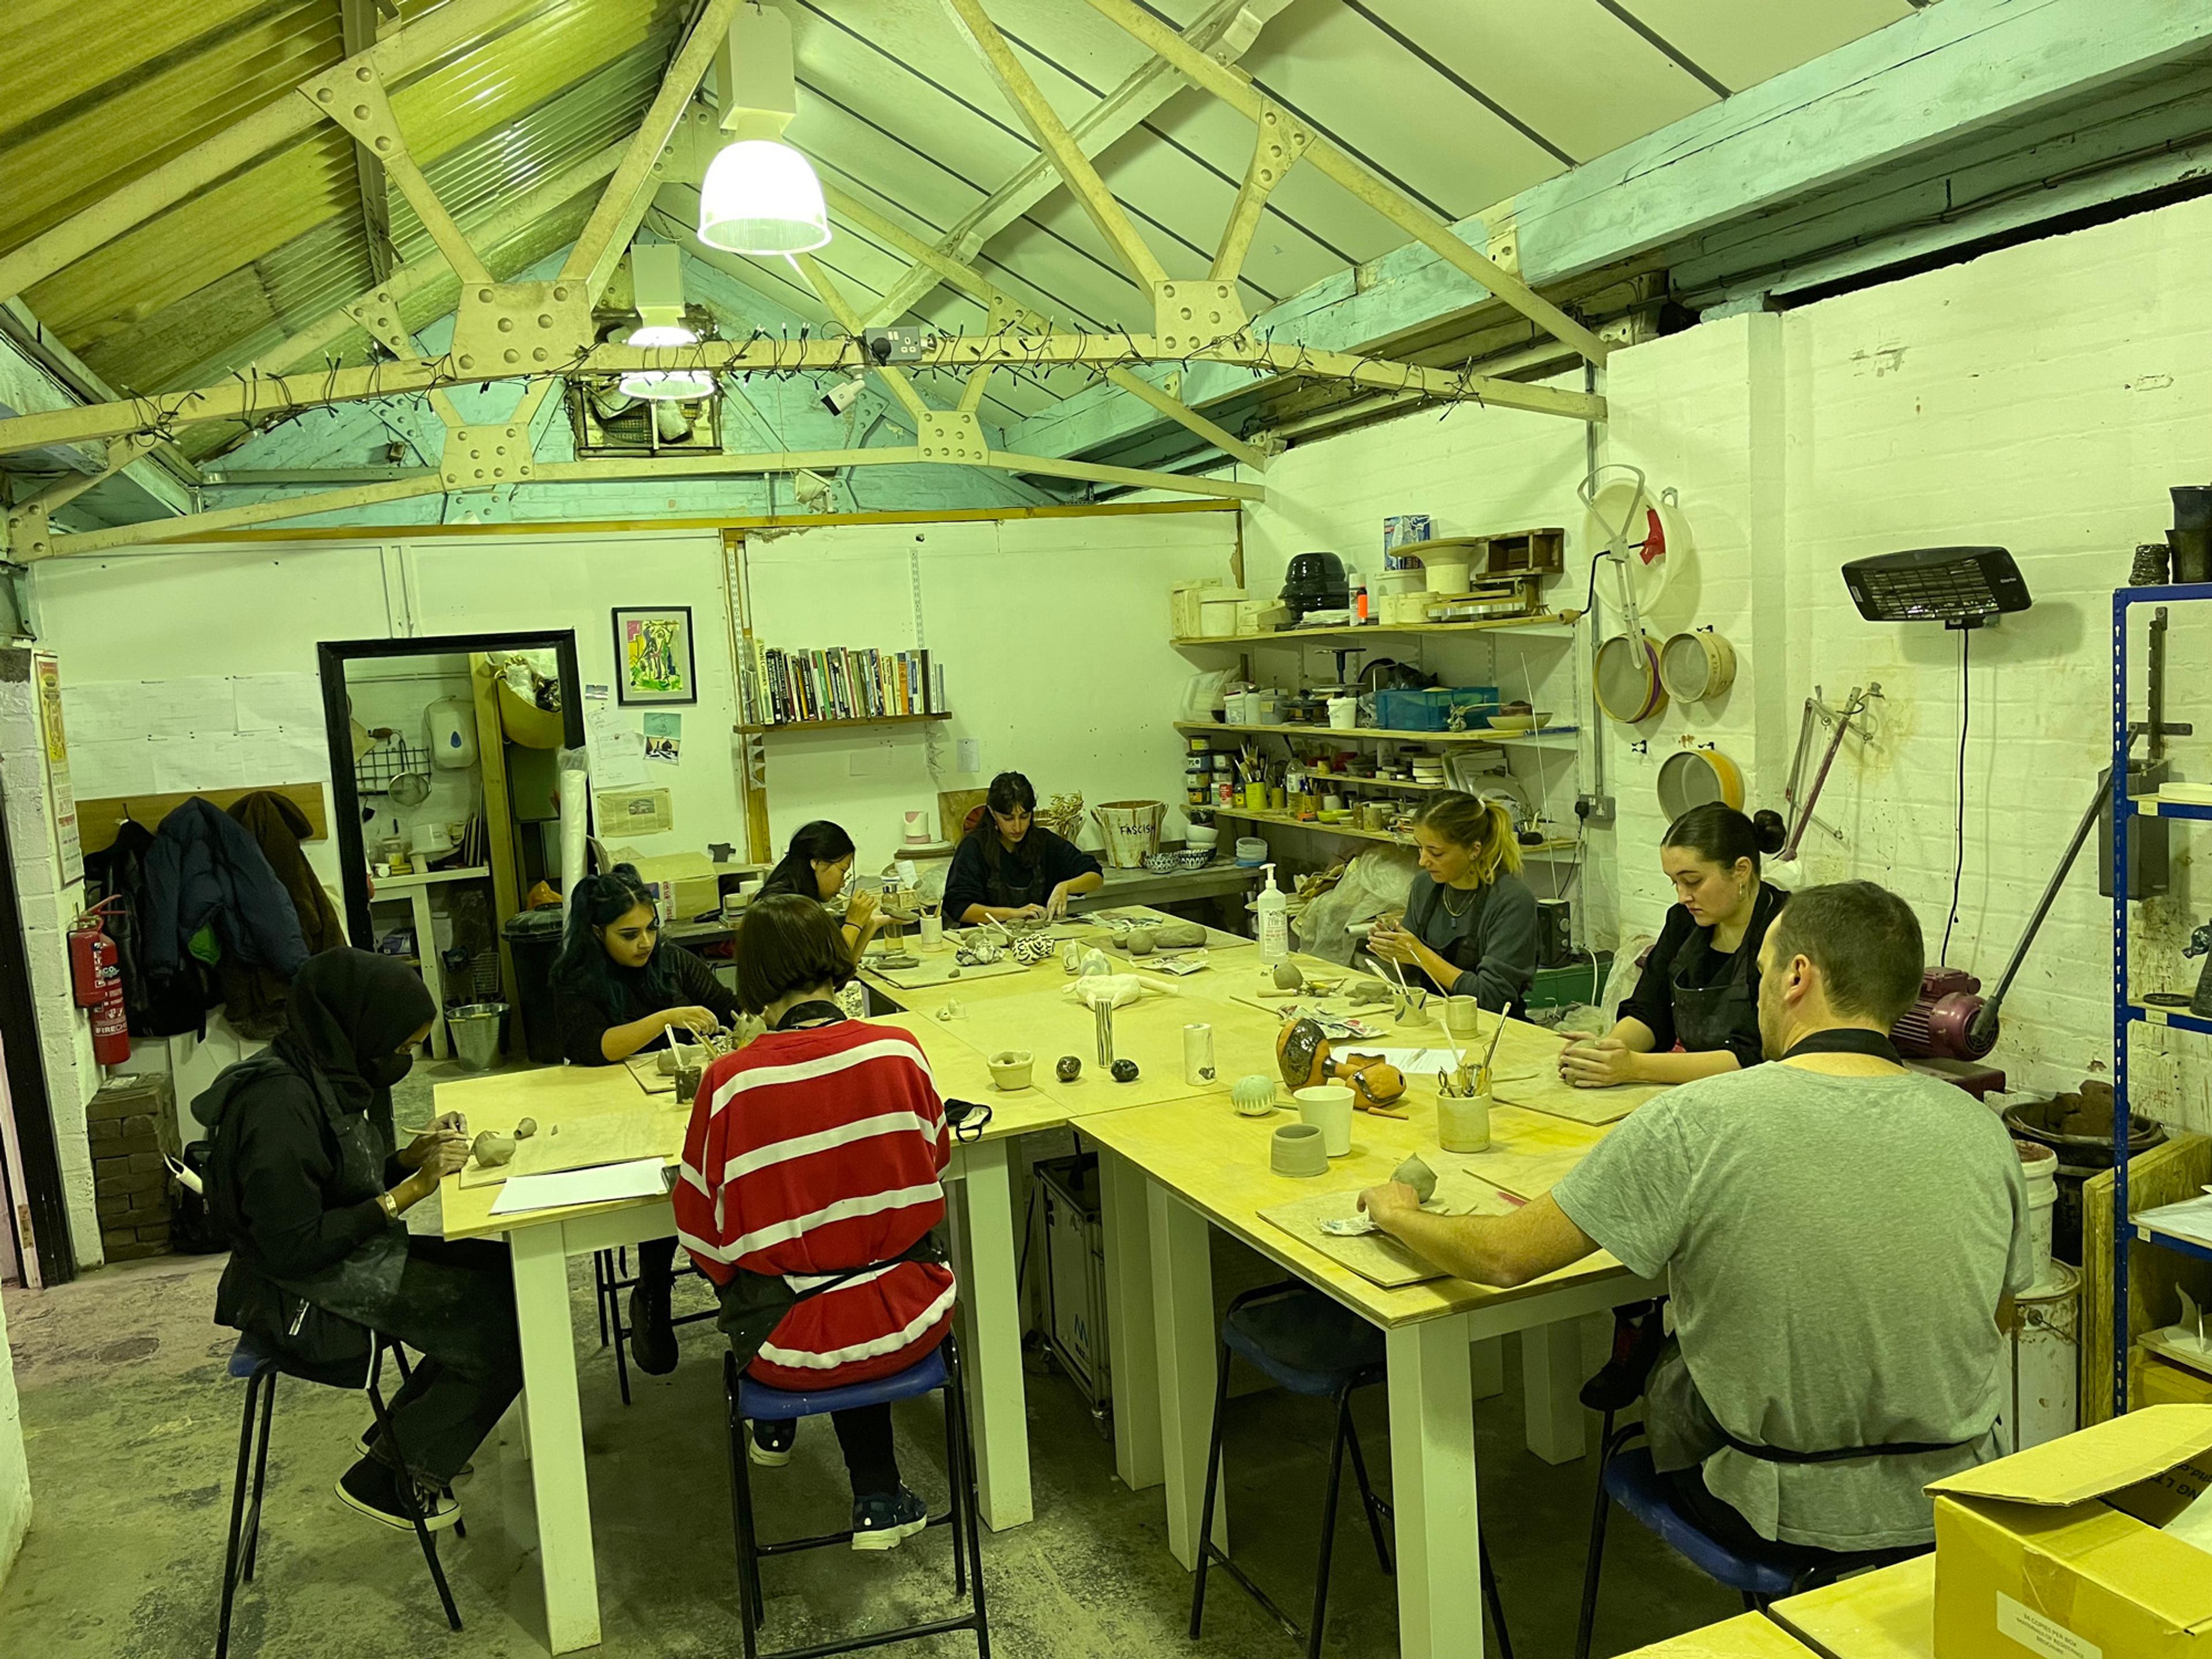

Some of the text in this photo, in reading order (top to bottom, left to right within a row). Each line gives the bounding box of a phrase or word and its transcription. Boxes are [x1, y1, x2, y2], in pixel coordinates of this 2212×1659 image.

[1120, 824, 1156, 835] FASCISM
[2176, 1484, 2202, 1500] NG
[2031, 1618, 2051, 1633] COPIES
[2064, 1637, 2077, 1647] BOX
